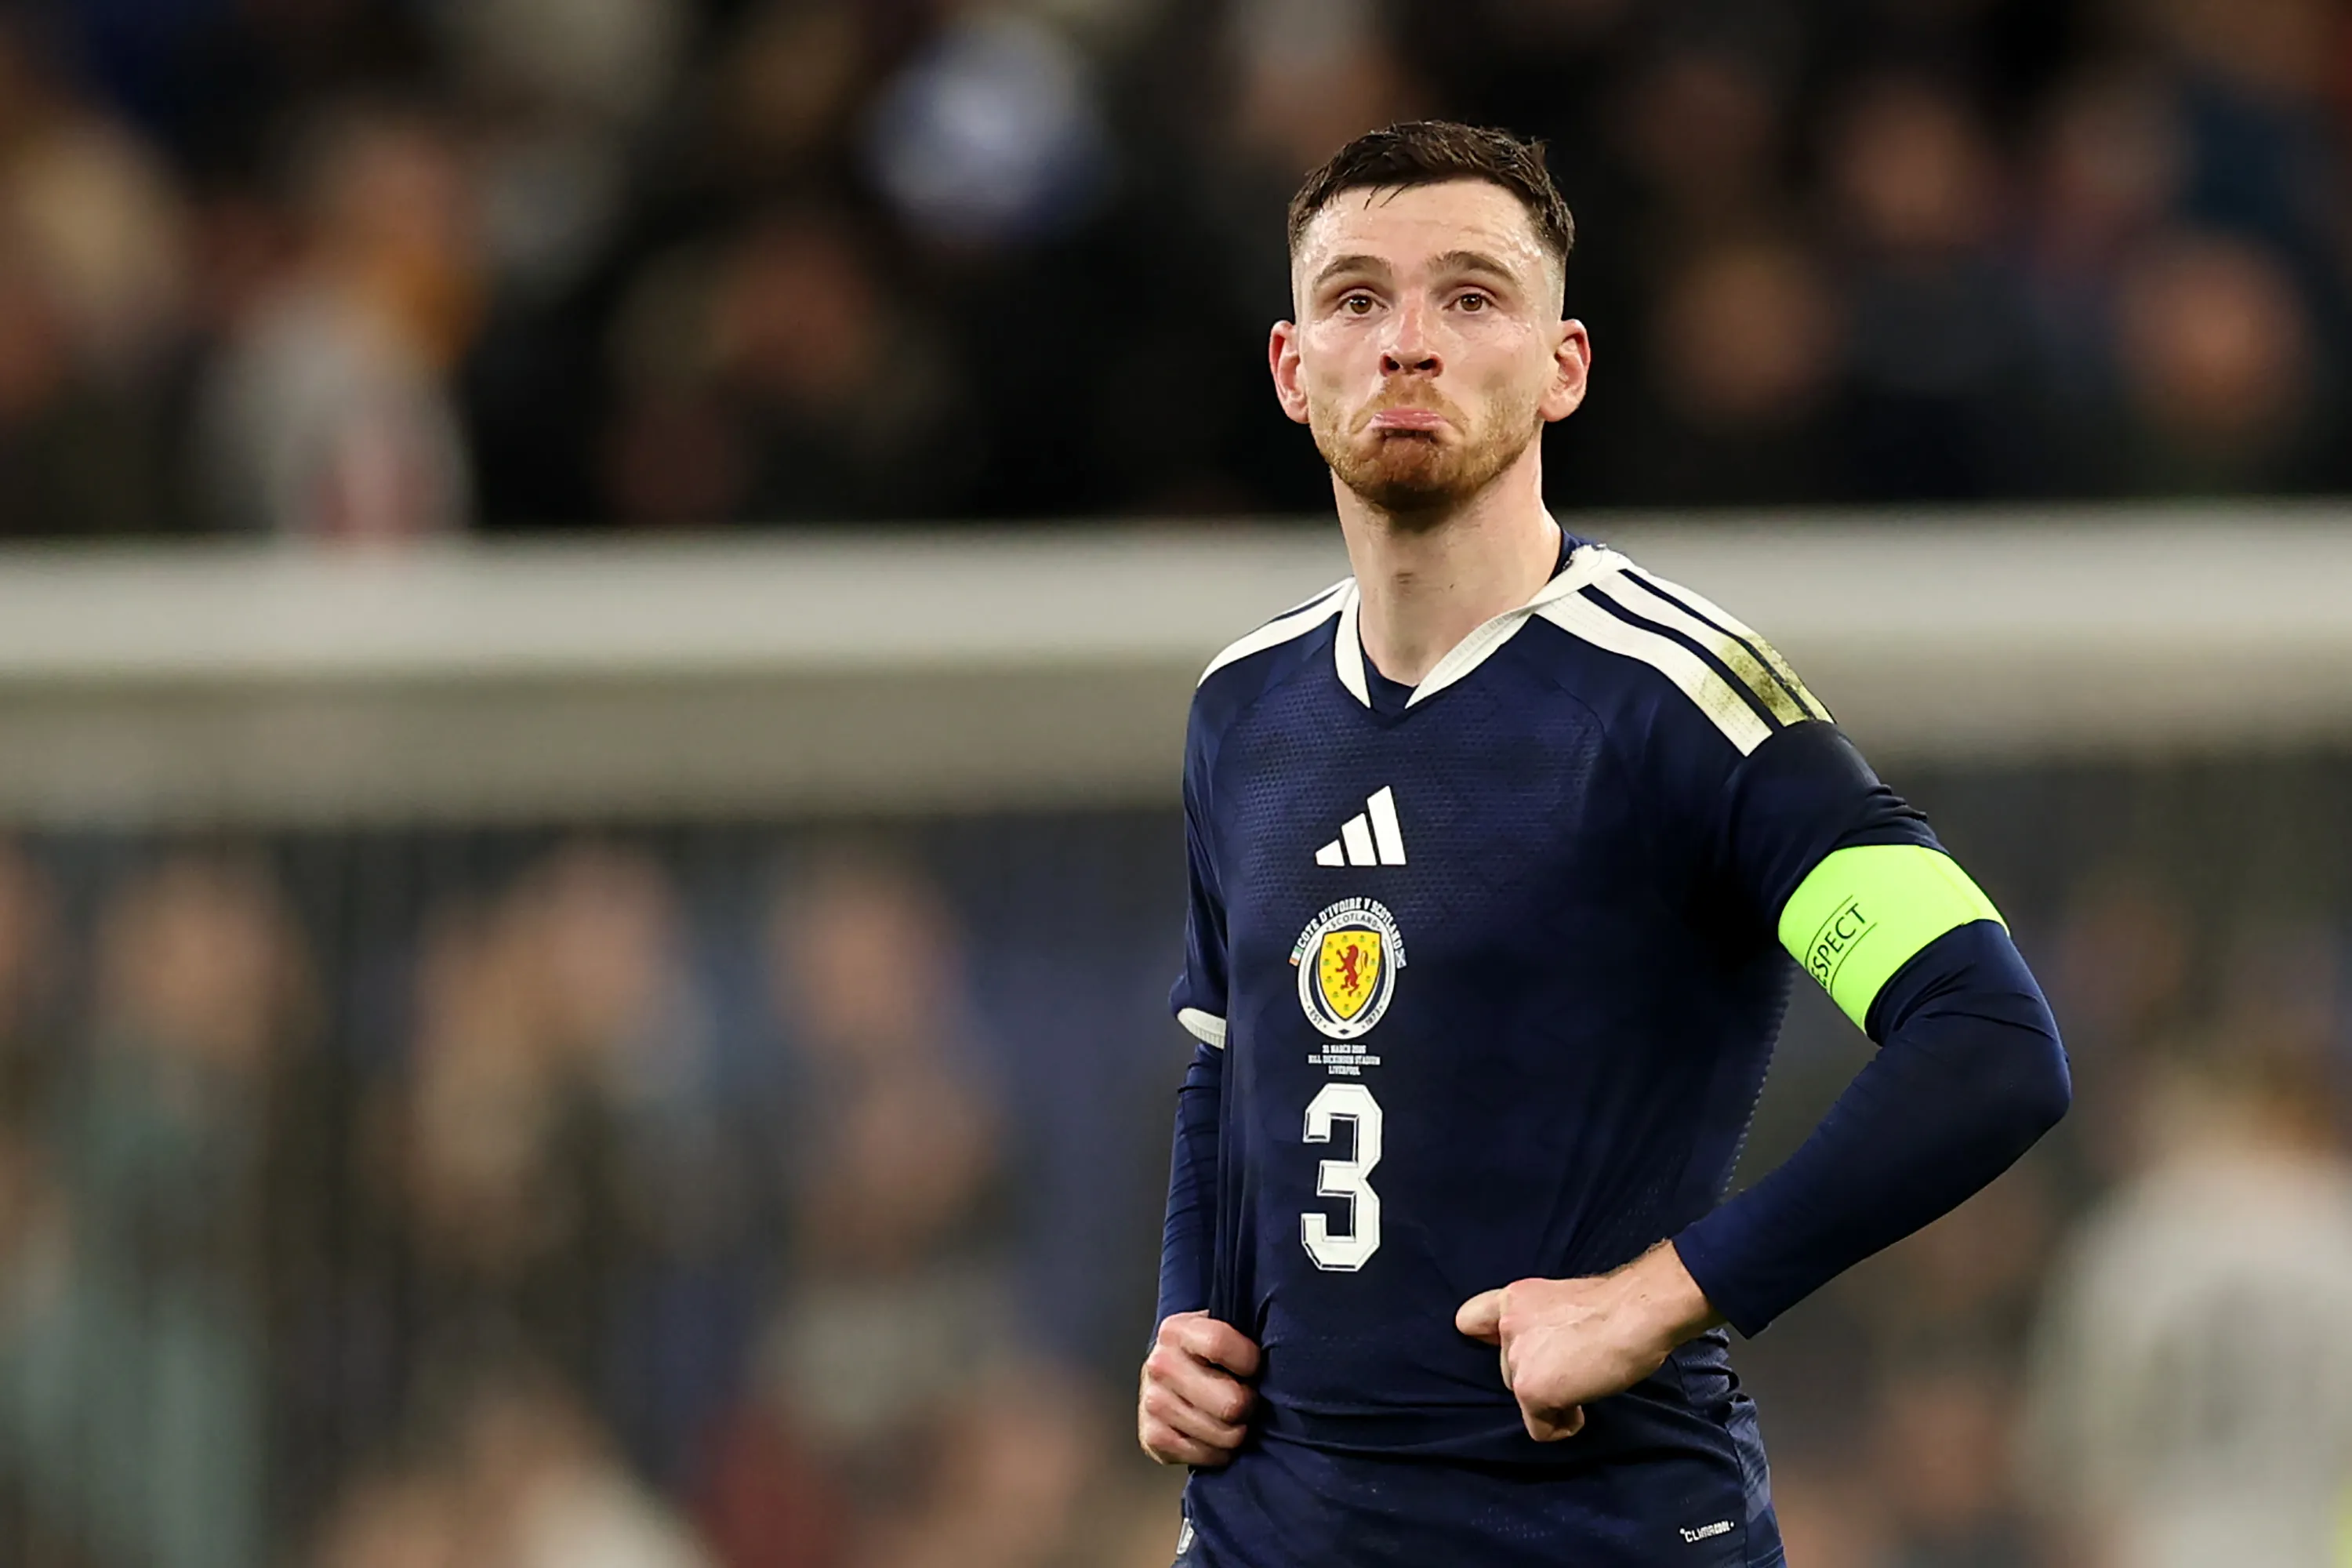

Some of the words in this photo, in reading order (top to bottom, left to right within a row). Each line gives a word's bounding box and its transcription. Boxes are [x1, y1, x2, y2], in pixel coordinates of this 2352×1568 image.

[1330, 912, 1377, 929] SCOTLAND
[1364, 898, 1371, 910] V
[1370, 900, 1403, 949] SCOTLAND
[1811, 902, 1865, 986] ESPECT
[1301, 1083, 1383, 1272] 3
